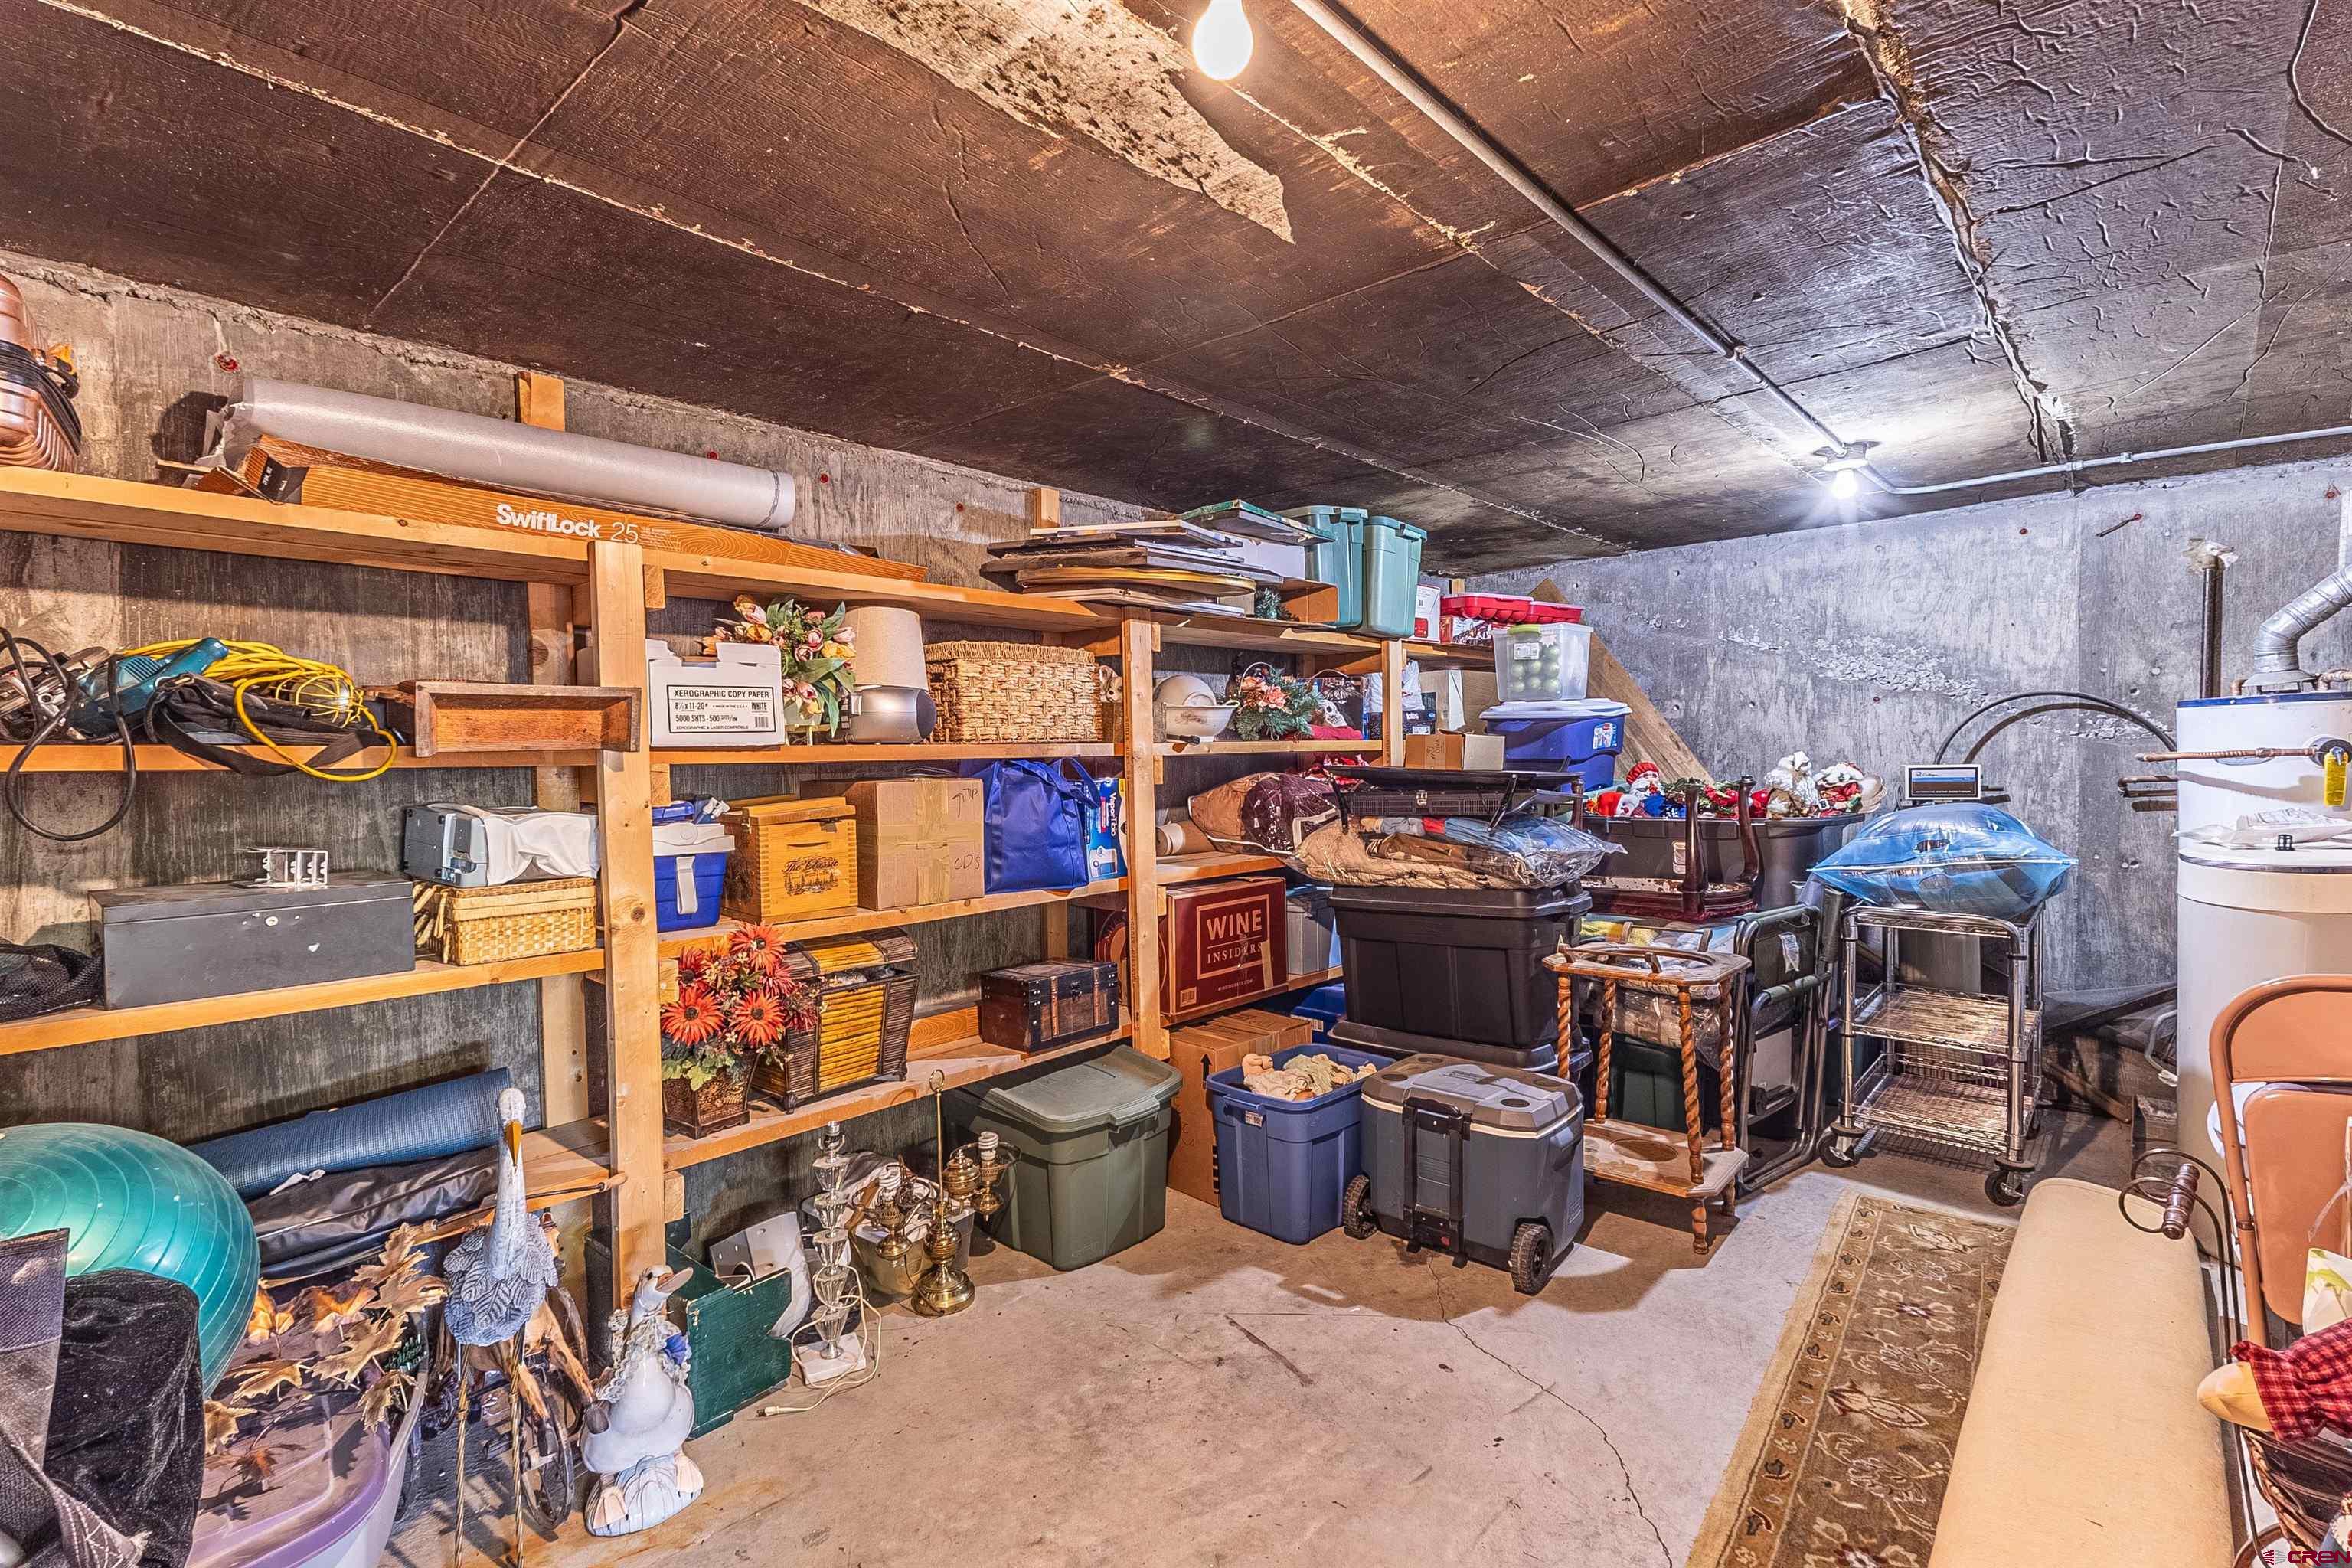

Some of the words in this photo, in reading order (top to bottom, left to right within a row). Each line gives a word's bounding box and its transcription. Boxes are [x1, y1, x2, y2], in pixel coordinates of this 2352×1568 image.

[496, 503, 600, 537] SwiftLock
[611, 522, 639, 543] 25
[1206, 908, 1263, 941] WINE
